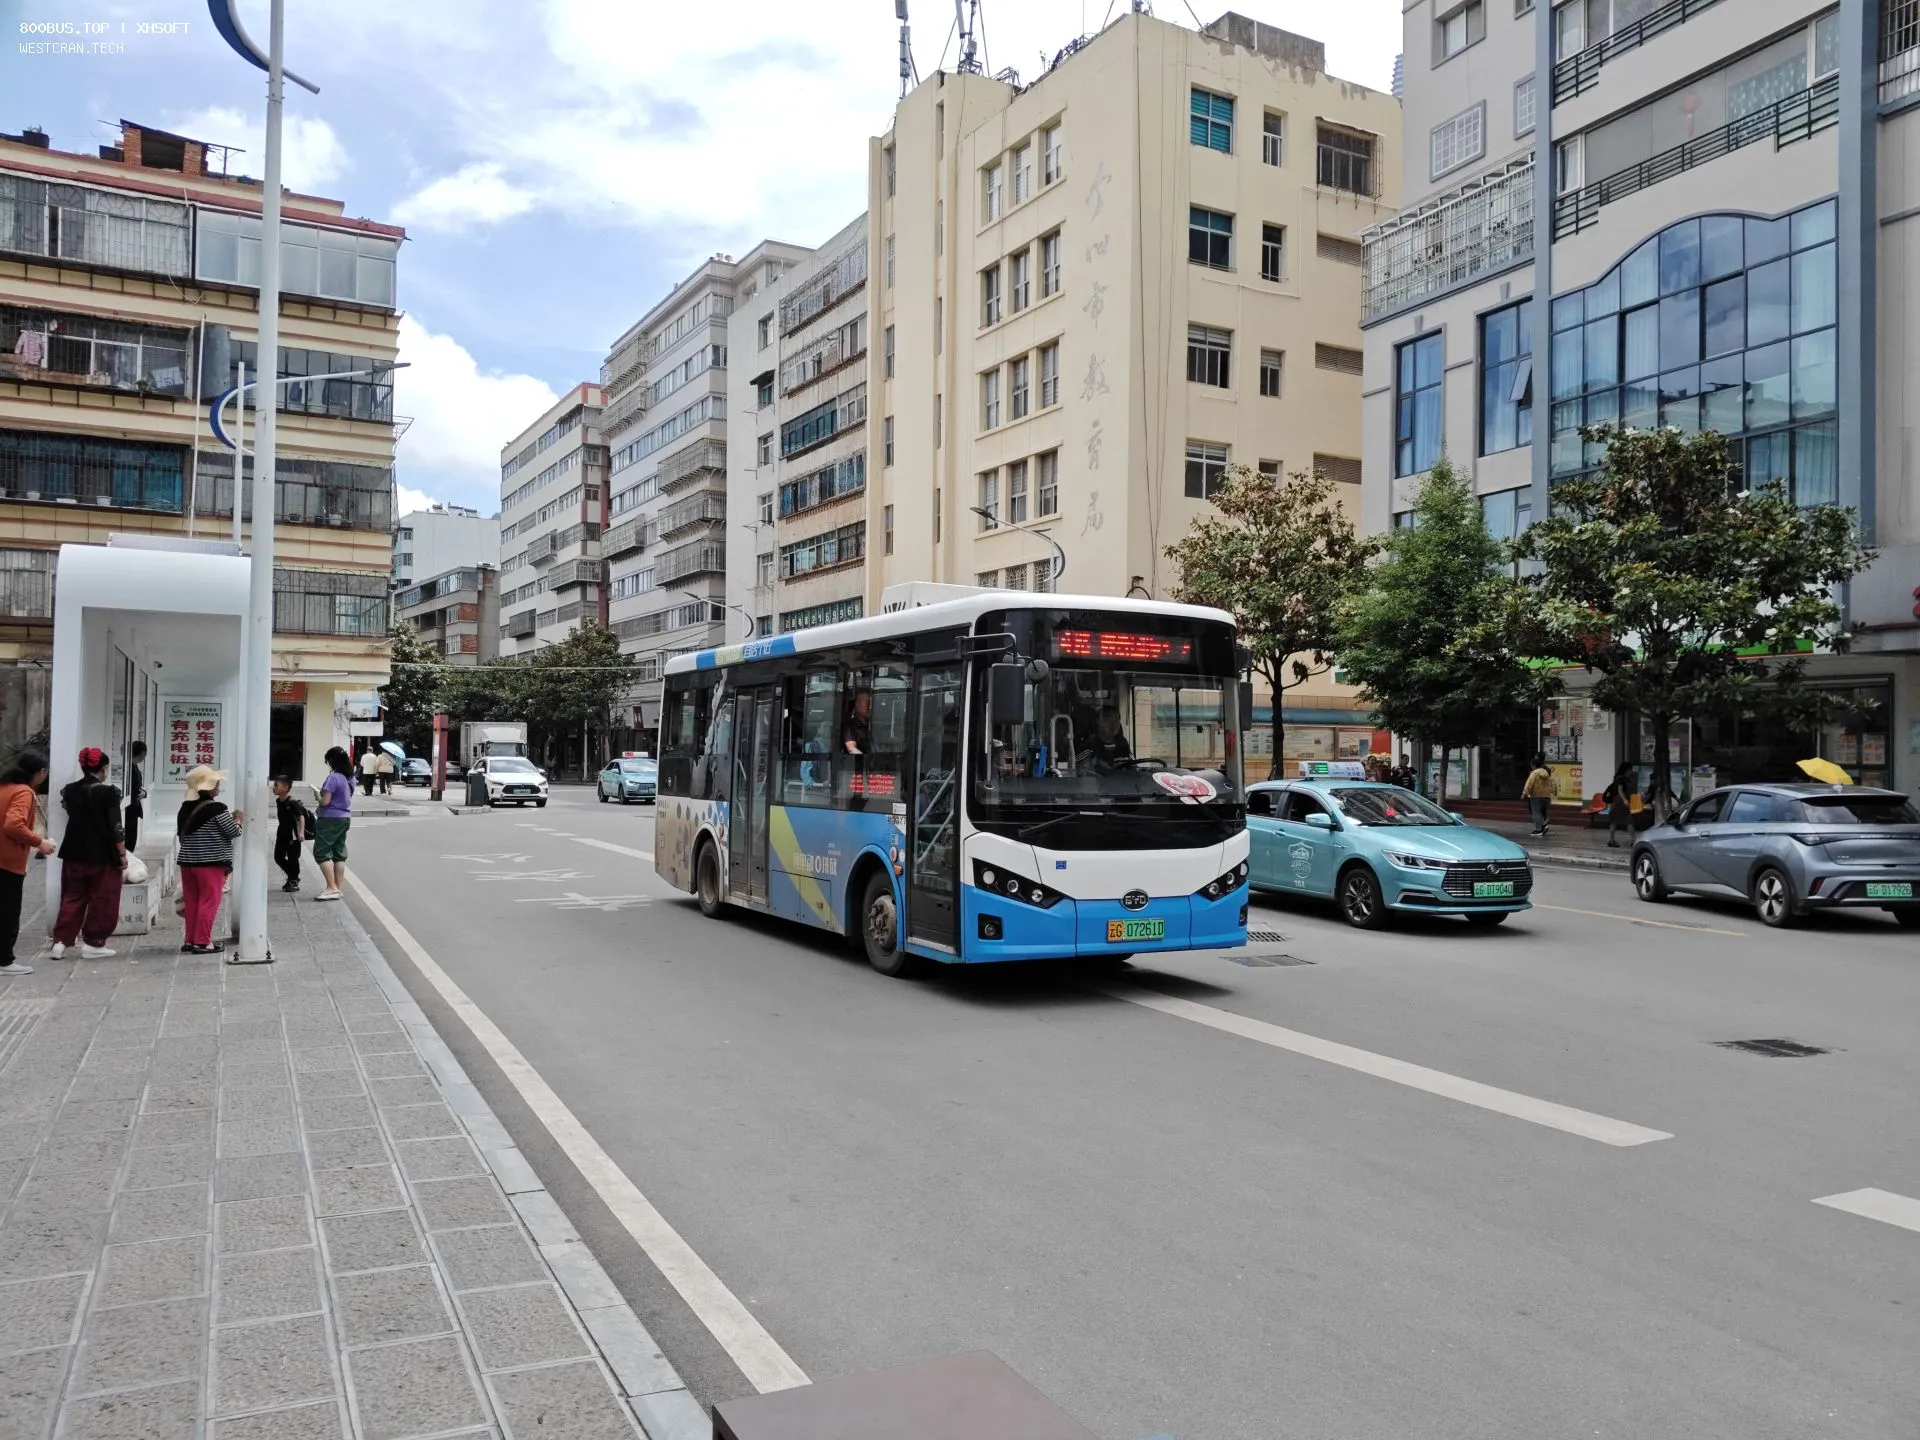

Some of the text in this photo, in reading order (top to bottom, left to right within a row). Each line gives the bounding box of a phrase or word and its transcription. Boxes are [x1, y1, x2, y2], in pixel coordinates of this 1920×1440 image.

[169, 720, 190, 764] 有充电桩
[195, 720, 215, 764] 停车场设
[1125, 895, 1146, 905] BYD
